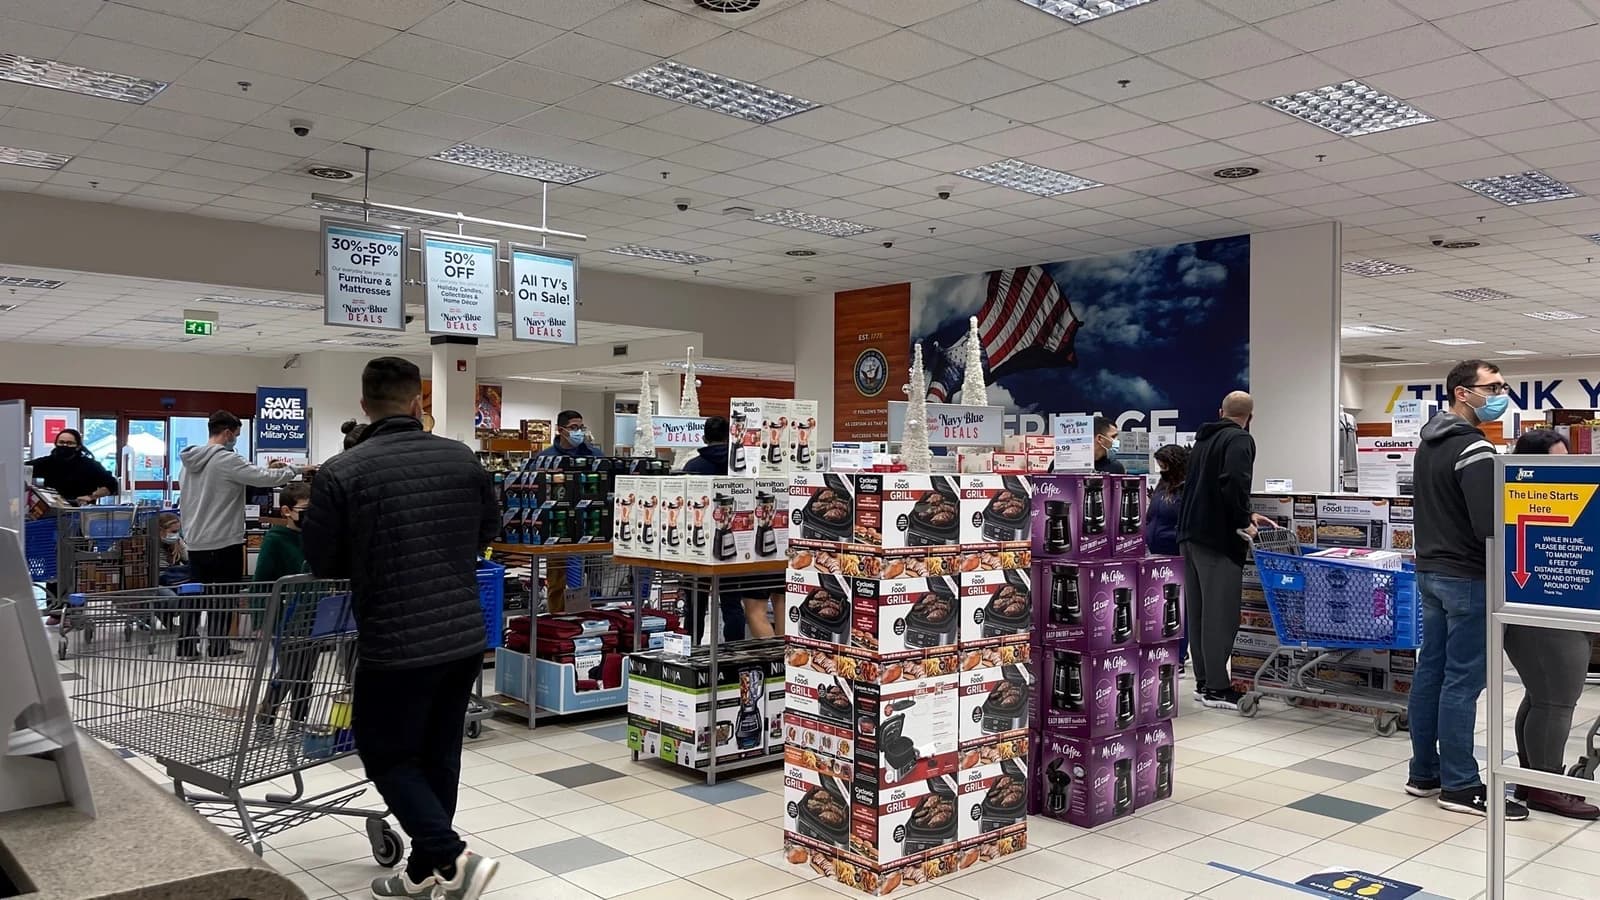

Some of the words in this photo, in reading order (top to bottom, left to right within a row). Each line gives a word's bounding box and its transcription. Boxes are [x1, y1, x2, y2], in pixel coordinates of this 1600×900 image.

[332, 238, 398, 256] 30%-50%
[350, 254, 380, 266] OFF
[444, 251, 475, 266] 50%
[444, 265, 474, 279] OFF
[338, 273, 382, 285] Furniture
[520, 274, 537, 286] All
[541, 276, 568, 290] TV's
[340, 284, 391, 296] Mattresses
[440, 290, 472, 300] Collectibles
[518, 288, 537, 302] On
[541, 292, 570, 306] Sale!
[342, 304, 366, 315] Navy
[367, 304, 388, 313] Blue
[348, 312, 382, 324] DEALS
[441, 313, 462, 323] Navy
[462, 313, 482, 322] Blue
[524, 316, 546, 328] Navy
[547, 317, 566, 326] Blue
[447, 322, 478, 332] DEALS
[530, 326, 562, 338] DEALS
[1408, 380, 1564, 410] THNK
[264, 397, 300, 408] SAVE
[260, 408, 304, 420] MORE!
[939, 414, 962, 427] Navy
[964, 412, 984, 424] Blue
[662, 422, 684, 434] Navy
[686, 421, 704, 431] Blue
[944, 426, 978, 438] DEALS
[260, 432, 288, 440] Military
[668, 433, 700, 442] DEALS
[790, 486, 812, 495] GRILL
[890, 492, 913, 500] GRILL
[966, 490, 988, 498] GRILL
[1040, 482, 1061, 498] Coffee
[1509, 490, 1526, 499] The
[1528, 490, 1548, 500] Line
[1550, 491, 1578, 500] Starts
[1530, 504, 1552, 513] Here
[1110, 570, 1126, 584] Coffee
[1160, 566, 1174, 580] Coffee
[788, 584, 808, 594] GRILL
[968, 586, 989, 595] GRILL
[887, 595, 910, 604] GRILL
[1144, 598, 1150, 606] 12
[1092, 603, 1099, 612] 12
[1156, 648, 1170, 662] Coffee
[630, 660, 647, 674] NINJA
[1112, 656, 1128, 670] Coffee
[662, 665, 681, 683] NINJA
[698, 672, 724, 686] NIA
[794, 676, 808, 685] Foodi
[1141, 680, 1146, 689] 12
[790, 684, 812, 697] GRILL
[966, 685, 988, 695] GRILL
[1096, 690, 1102, 700] 12
[1152, 729, 1167, 743] Coffee
[1062, 745, 1082, 758] Coffee
[1111, 742, 1125, 757] Coffee
[790, 769, 802, 779] Foodi
[1137, 764, 1143, 772] 12
[785, 778, 807, 791] GRILL
[964, 781, 986, 793] GRILL
[1094, 780, 1101, 788] 12
[854, 786, 874, 797] Cyclonic
[890, 792, 906, 801] Foodi
[856, 793, 873, 804] Grilling
[886, 801, 911, 814] GRILL
